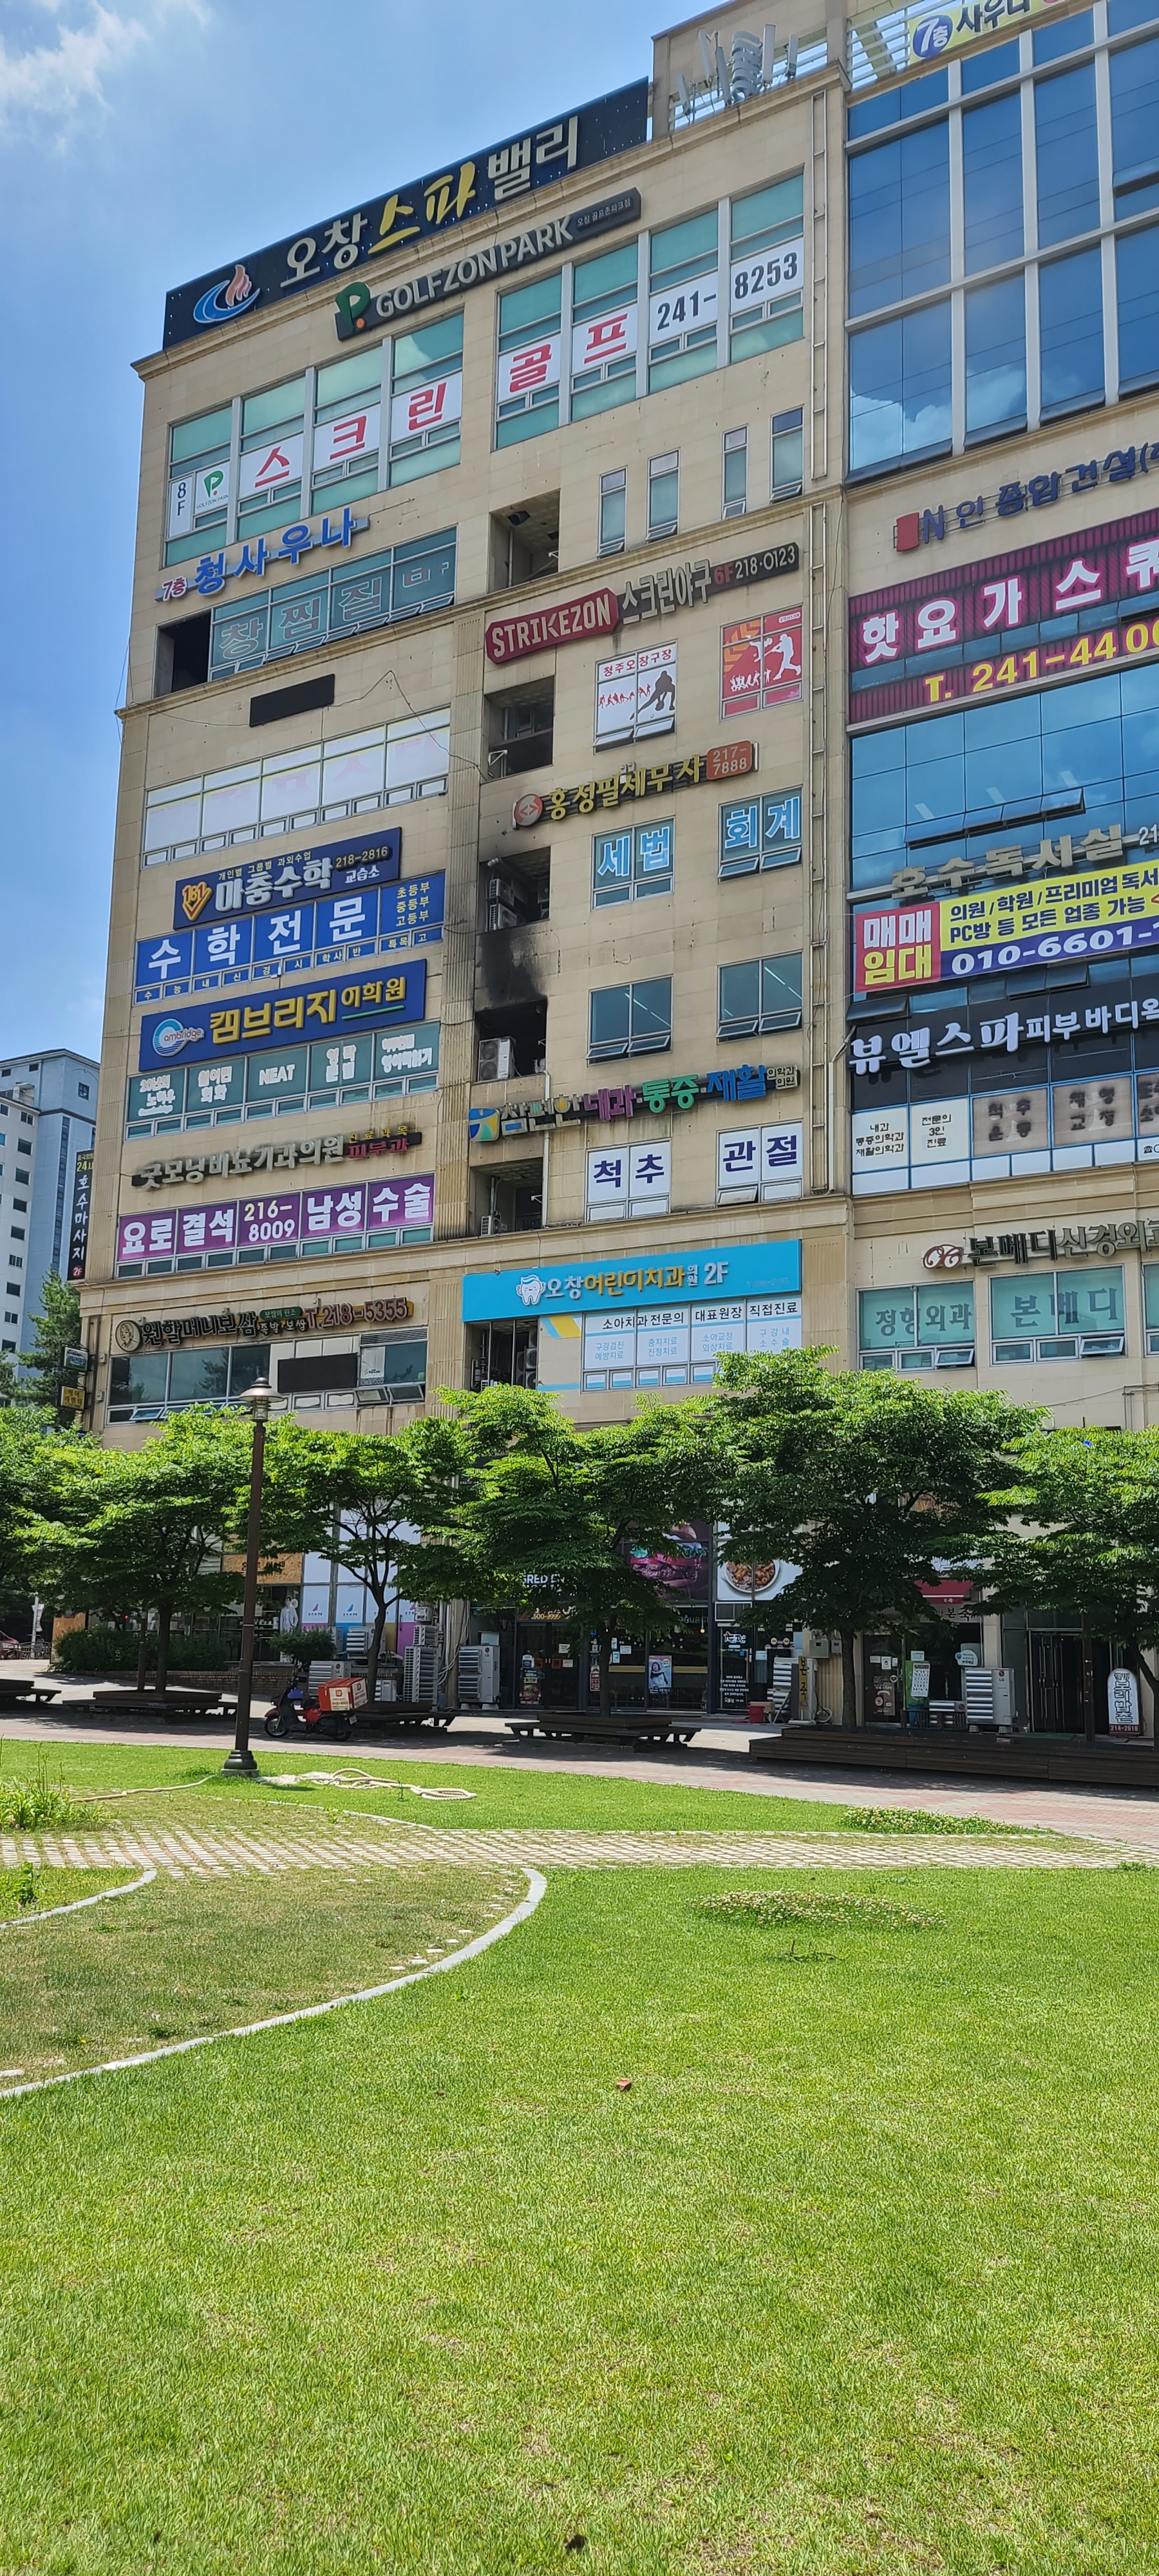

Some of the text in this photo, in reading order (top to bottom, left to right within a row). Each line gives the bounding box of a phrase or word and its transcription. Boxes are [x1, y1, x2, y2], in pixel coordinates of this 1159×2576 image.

[916, 17, 948, 53] 7층
[163, 507, 356, 601] 7층 청사우나
[491, 593, 611, 658] STRIKEZON
[622, 559, 711, 625] 스크린야구
[714, 564, 733, 585] 6F
[713, 757, 748, 776] 7888
[726, 796, 801, 849] 회계
[278, 851, 311, 867] 과외수업
[335, 846, 388, 868] 218-2816
[598, 825, 671, 880] 세법
[891, 823, 1124, 899] 호수독서실
[218, 861, 272, 880] 개인별 그룹별
[344, 866, 381, 884] 교습소
[397, 881, 429, 899] 초등부
[950, 902, 985, 922] 의원
[997, 891, 1034, 913] 학원
[1046, 876, 1117, 904] 프리미엄
[396, 895, 429, 913] 중등부
[395, 909, 429, 927] 고등부
[863, 909, 932, 948] 매매
[950, 896, 1145, 943] PC방 등 모든 업종 가능
[952, 923, 1158, 974] 010-6601-
[863, 944, 932, 985] 임대
[210, 989, 337, 1045] 캠브리지
[341, 976, 407, 1009] 어학원
[849, 1011, 1024, 1075] 뷰엘스파
[259, 1064, 296, 1086] NEAT
[767, 1065, 795, 1081] 의학과
[776, 1076, 796, 1090] 의원
[870, 1122, 889, 1133] 내과
[922, 1114, 951, 1126] 전문의
[928, 1126, 945, 1136] 3인
[348, 1139, 409, 1159] 피부과
[856, 1132, 904, 1146] 통증의학과
[927, 1137, 947, 1148] 진료
[140, 1134, 344, 1189] 굿모닝비뇨기과의원
[722, 1135, 798, 1173] 관절
[856, 1144, 904, 1157] 재활의학과
[592, 1154, 664, 1188] 척추
[72, 1175, 90, 1260] 호수마사지
[244, 1201, 292, 1222] 216-
[249, 1218, 295, 1243] 8009
[73, 1266, 82, 1276] 2F
[704, 1261, 729, 1285] 2F
[602, 1302, 798, 1330] 소아치과 전문의 대표원장 직접진료
[875, 1302, 974, 1336] 정형외과
[1010, 1288, 1119, 1329] 본메디
[142, 1311, 257, 1347] 원할머니보쌈
[702, 1331, 733, 1342] 소아교정
[596, 1341, 624, 1351] 구강검진
[648, 1336, 677, 1347] 충치치료
[648, 1346, 677, 1357] 진정치료
[702, 1341, 733, 1352] 외상치료
[595, 1350, 624, 1361] 예방치료
